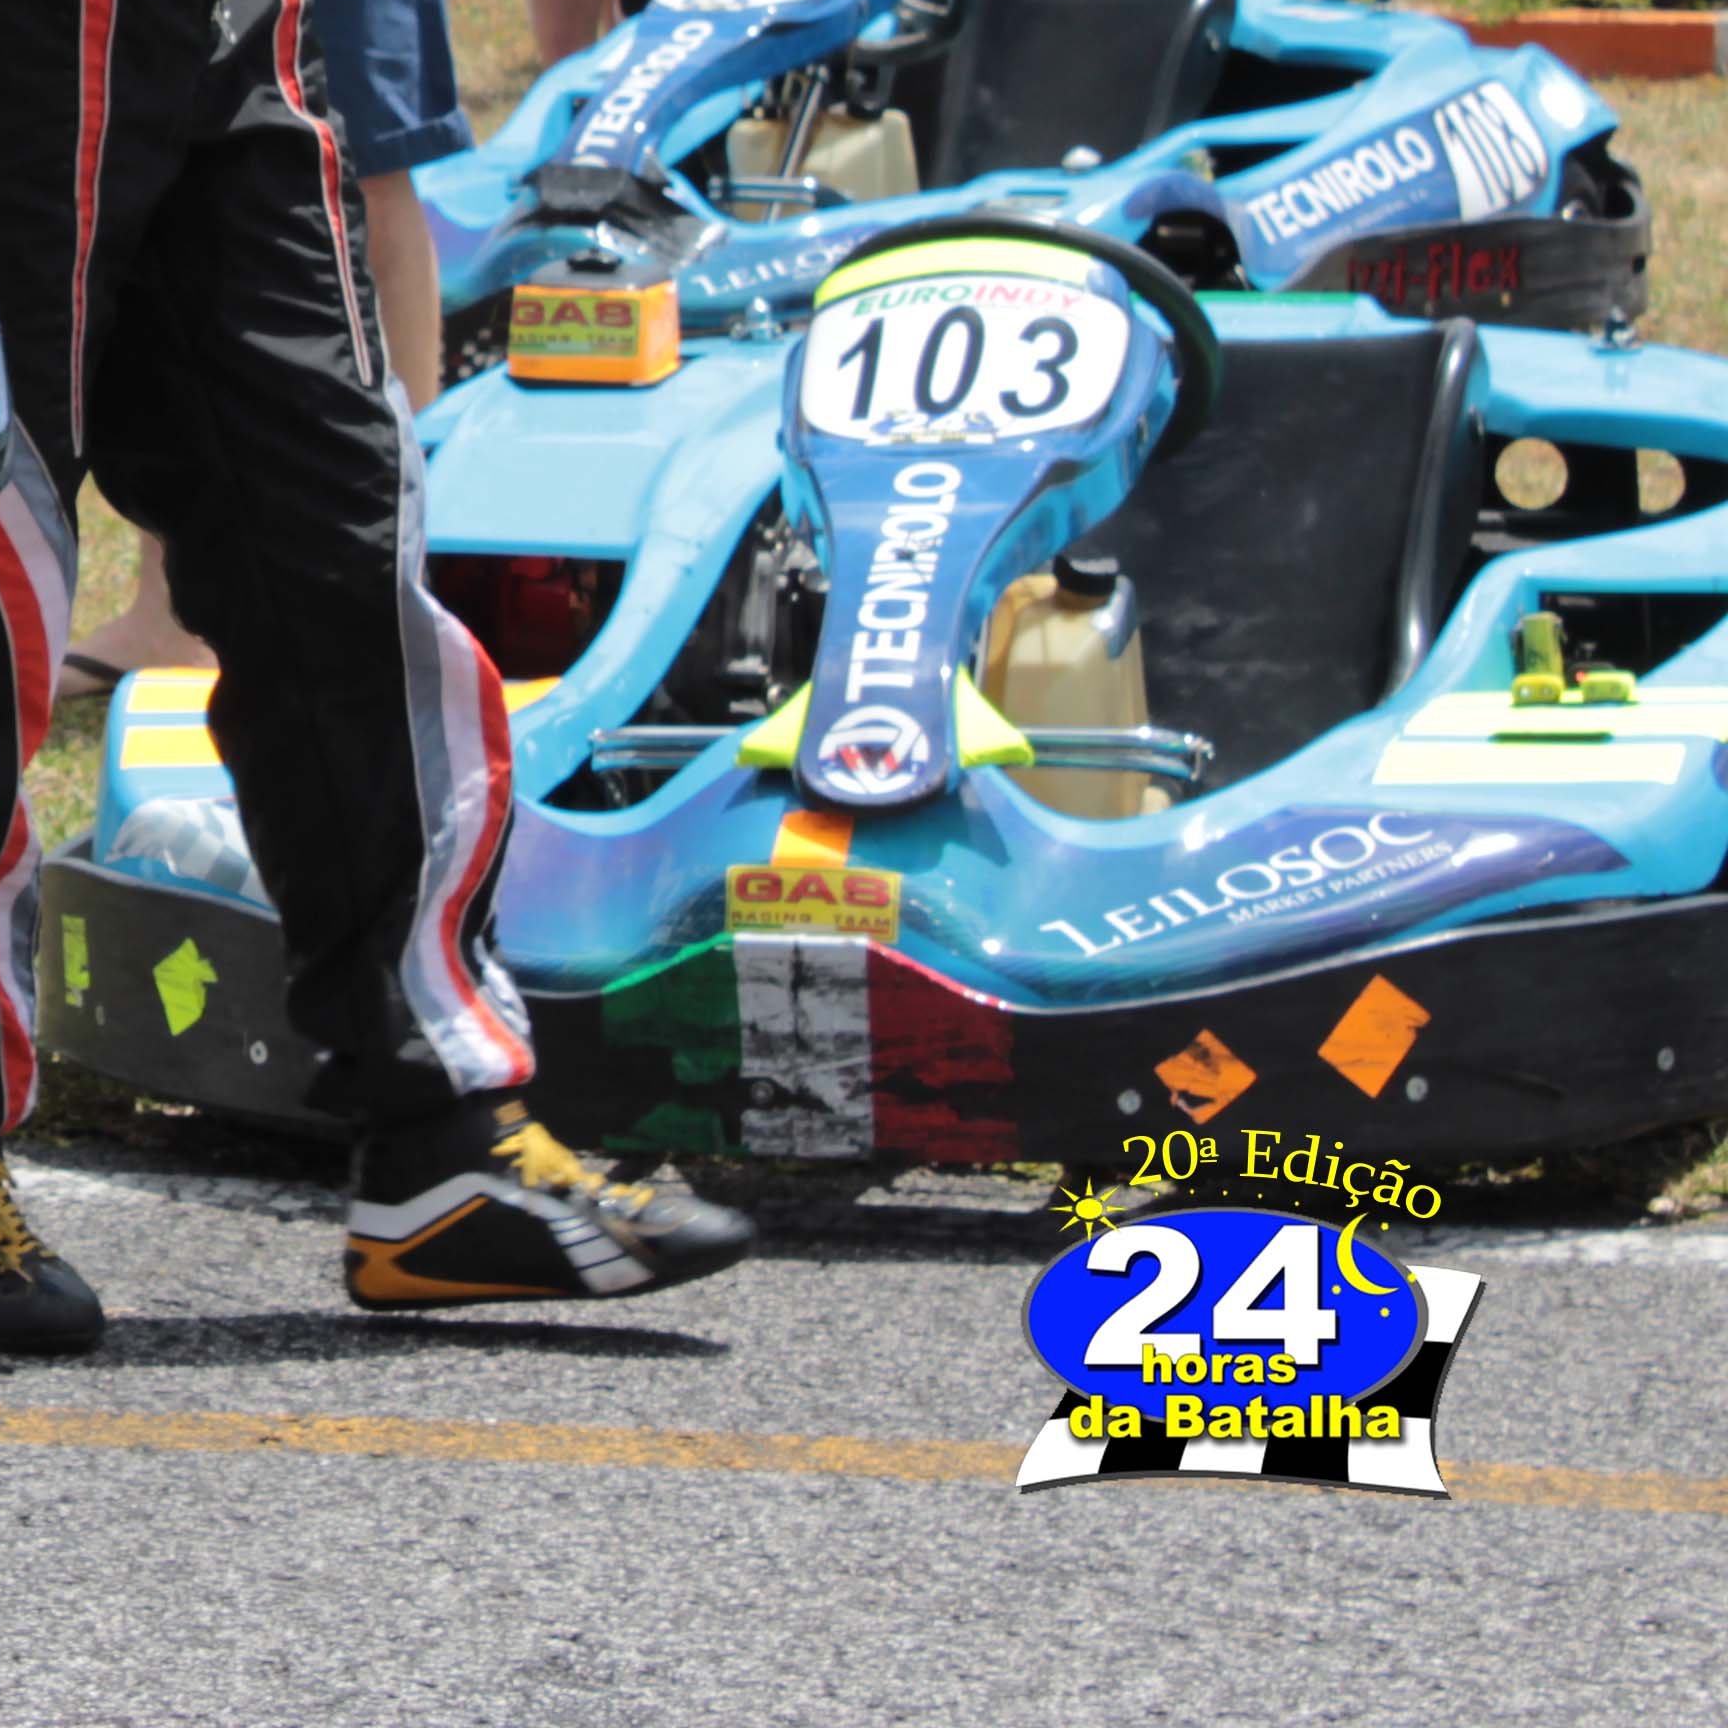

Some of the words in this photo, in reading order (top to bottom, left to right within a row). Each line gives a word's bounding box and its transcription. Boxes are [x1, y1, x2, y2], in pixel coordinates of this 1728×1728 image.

[1245, 127, 1436, 246] TECNIROLO
[838, 304, 1079, 421] 103
[845, 461, 963, 704] TECNIROLO
[730, 910, 812, 925] RACING
[834, 912, 891, 928] TEAM
[734, 871, 891, 909] GAS
[1038, 810, 1433, 959] LEILOSOC
[1227, 884, 1327, 927] MARKET
[1328, 841, 1455, 896] PARTNERS
